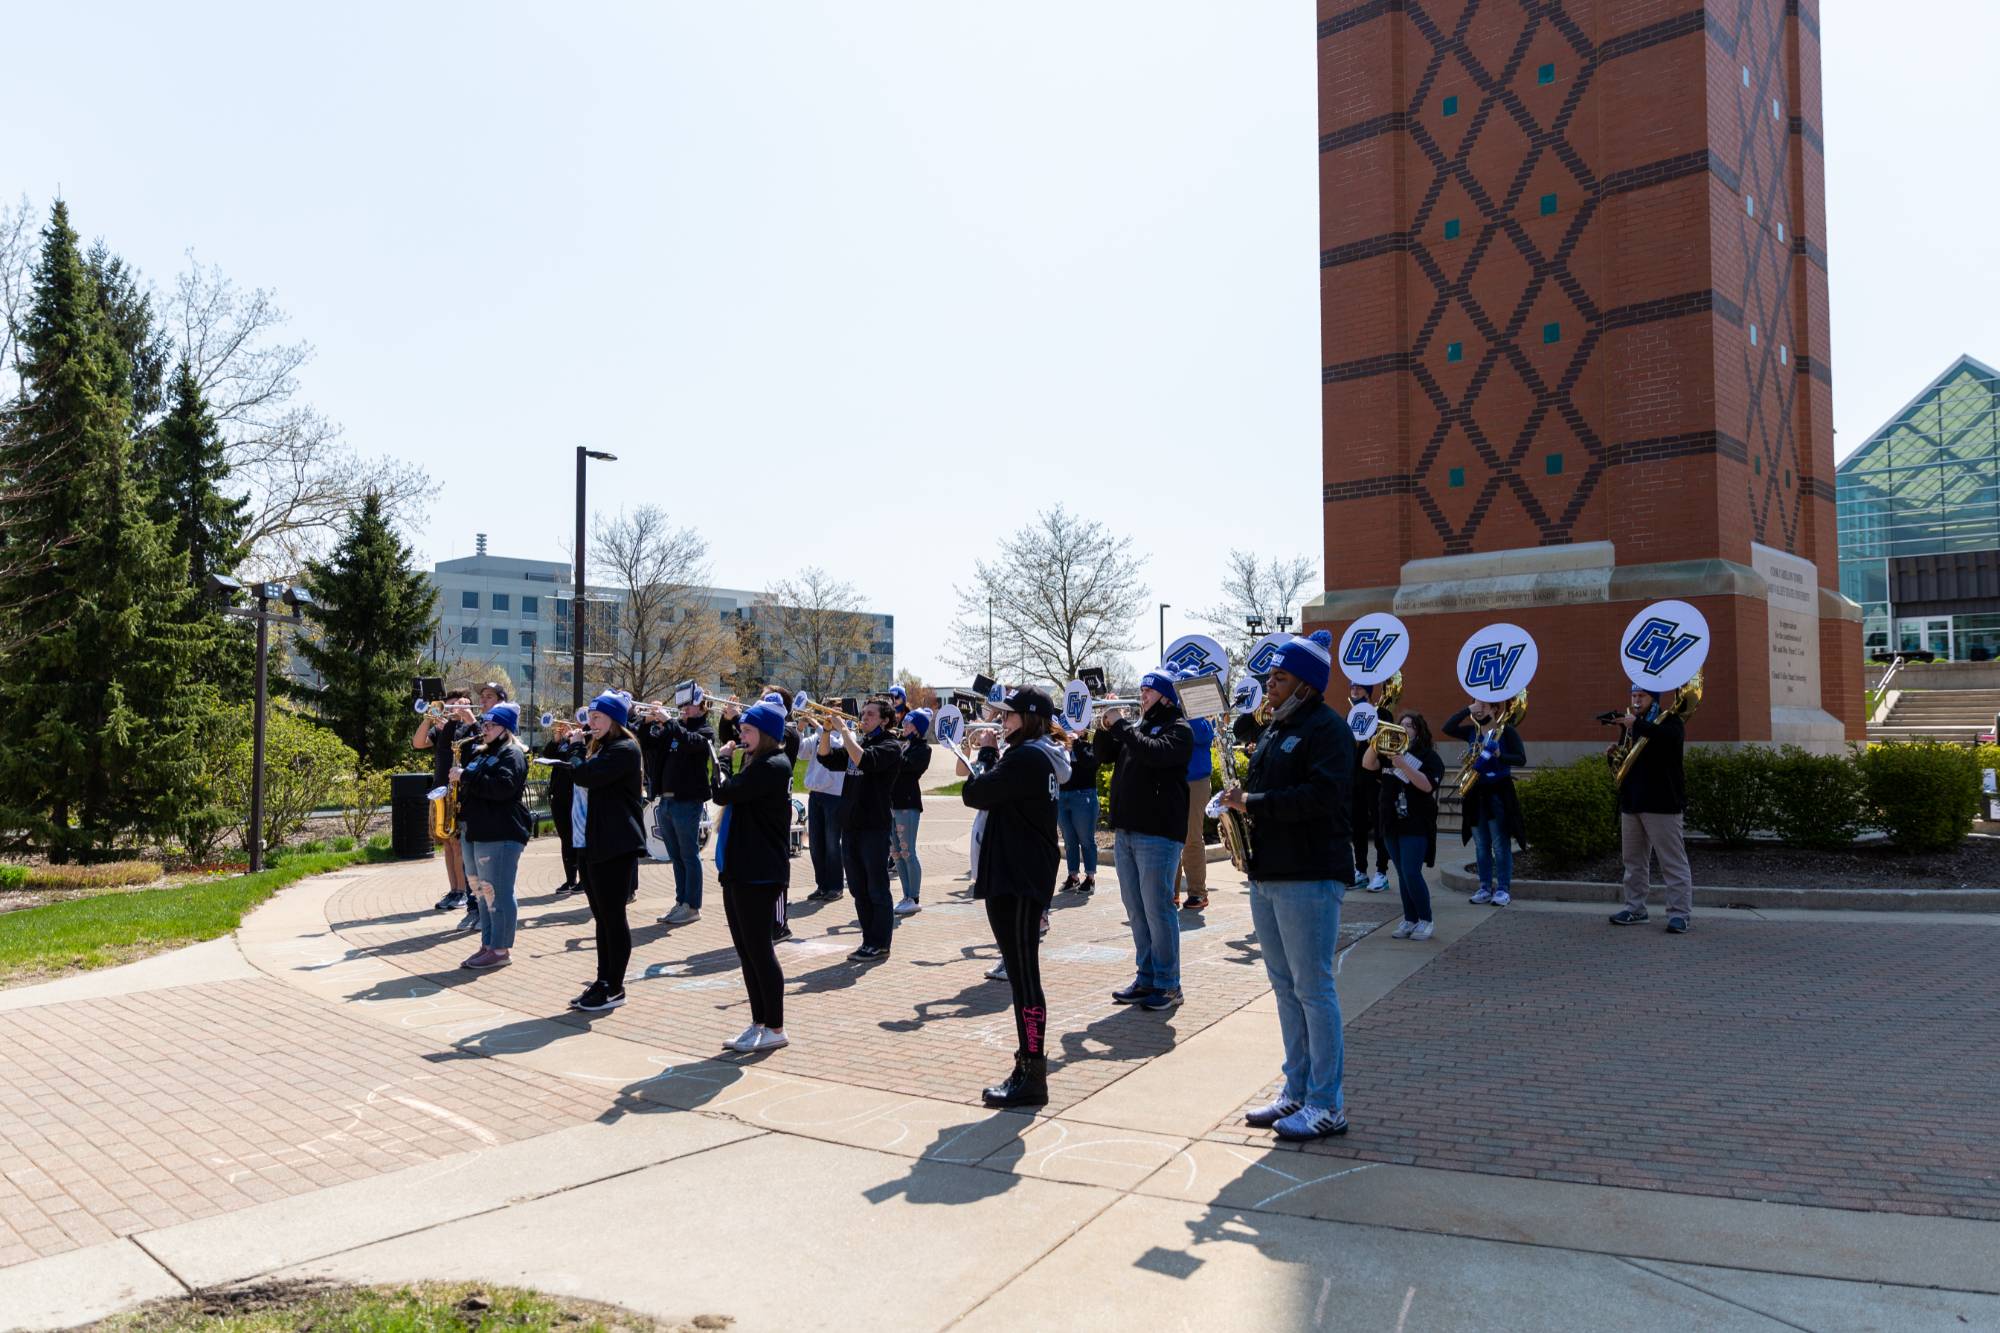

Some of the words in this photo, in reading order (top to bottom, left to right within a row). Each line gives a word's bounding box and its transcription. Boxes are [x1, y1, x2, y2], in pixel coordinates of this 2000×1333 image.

[1248, 643, 1275, 674] G
[1343, 628, 1400, 672] GV
[1625, 617, 1700, 676] GV
[1465, 642, 1527, 691] GV
[1066, 691, 1086, 722] GV
[1352, 712, 1375, 735] GV
